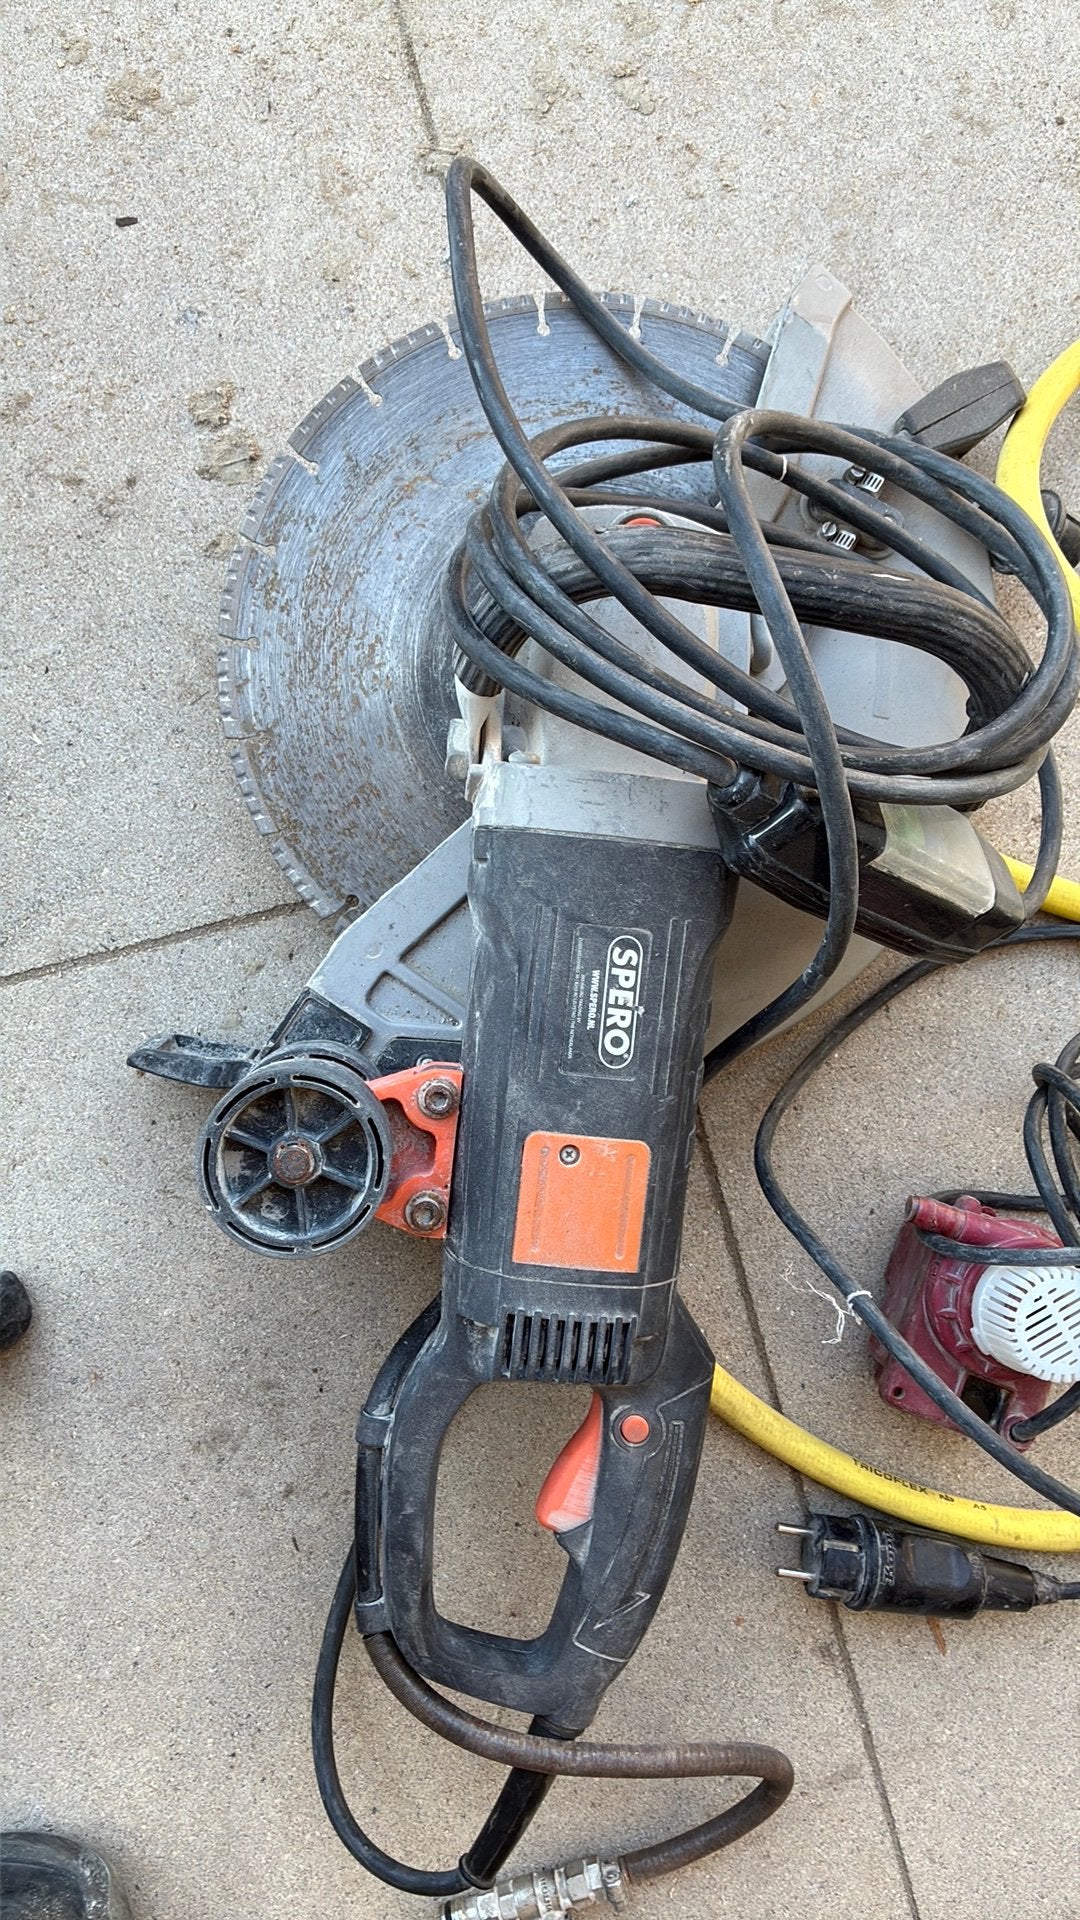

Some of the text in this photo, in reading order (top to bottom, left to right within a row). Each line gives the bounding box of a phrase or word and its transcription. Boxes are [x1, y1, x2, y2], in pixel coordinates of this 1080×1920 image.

[587, 969, 600, 1030] WWW.SPERO.NL
[604, 947, 638, 1056] SPERO
[852, 1458, 929, 1496] TRICOFLEX
